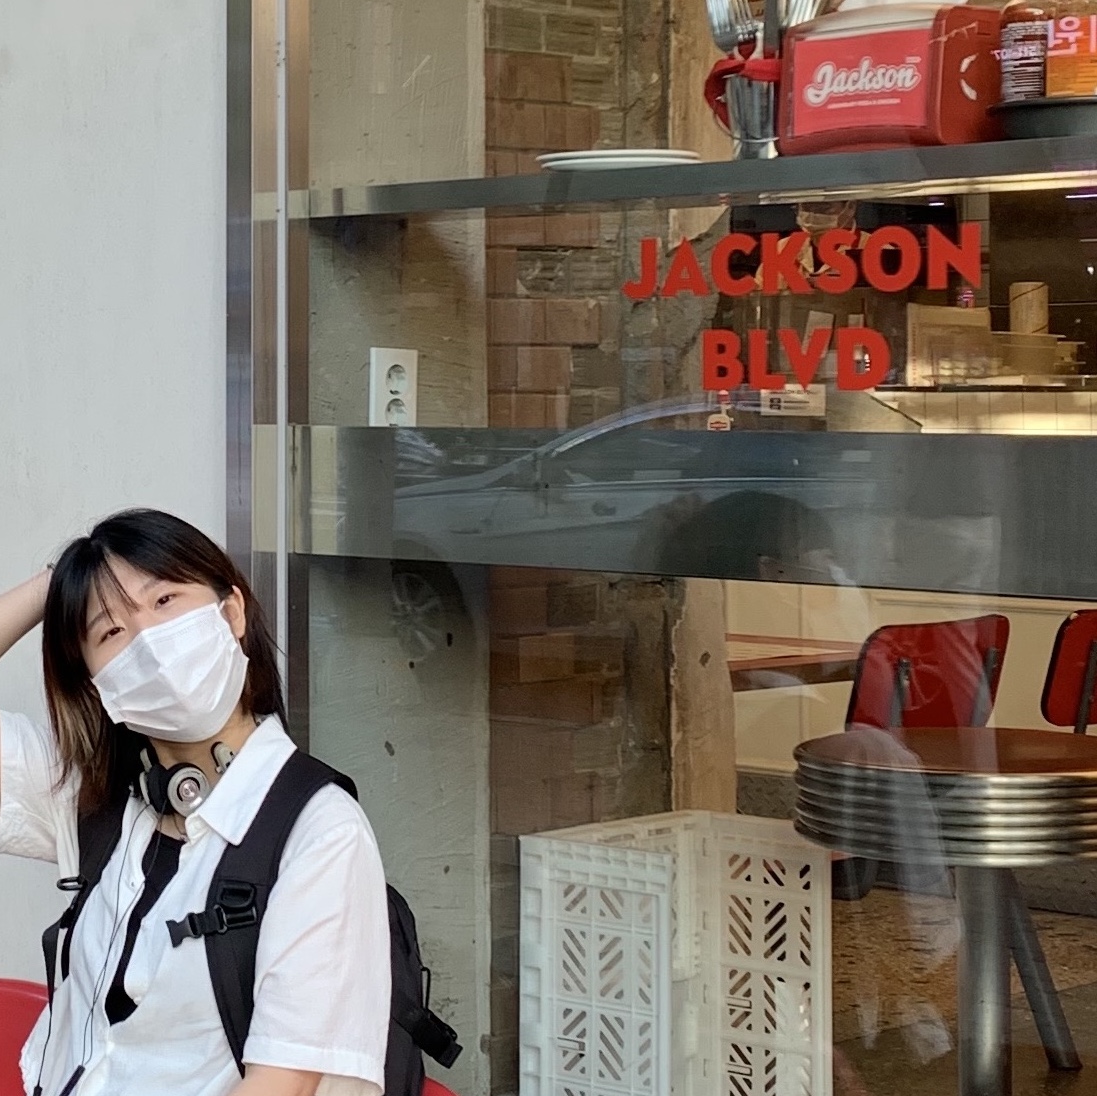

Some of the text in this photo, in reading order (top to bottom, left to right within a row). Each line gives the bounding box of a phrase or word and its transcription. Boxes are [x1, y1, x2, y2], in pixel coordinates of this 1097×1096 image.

[805, 57, 920, 105] Jackson
[622, 222, 982, 301] JACKSON
[703, 326, 891, 391] BLVD
